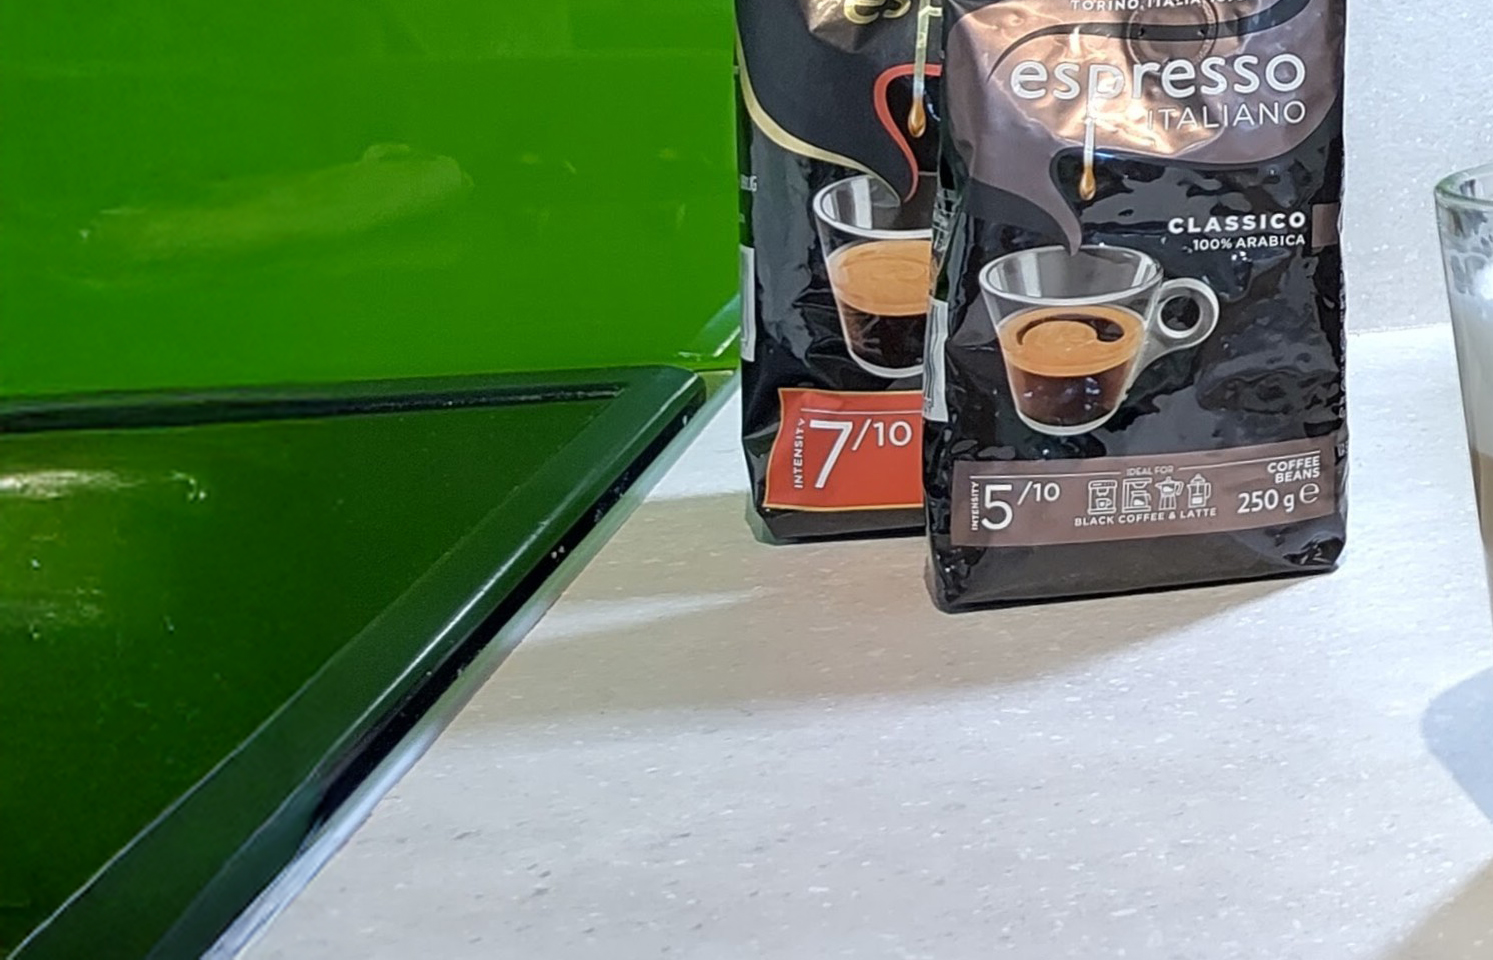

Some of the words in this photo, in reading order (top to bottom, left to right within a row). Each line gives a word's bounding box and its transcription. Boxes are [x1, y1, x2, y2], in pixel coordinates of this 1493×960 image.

[1010, 53, 1306, 112] espresso
[1147, 100, 1306, 131] ITALIANO
[1167, 211, 1307, 235] CLASSICO
[1193, 237, 1233, 251] 100%
[1235, 233, 1306, 249] ARABICA
[793, 417, 806, 489] INTENSITY
[1267, 455, 1320, 473] COFFEE
[1126, 467, 1153, 477] IDEAL
[1154, 465, 1174, 475] FOR
[1275, 467, 1320, 484] BEANS
[969, 480, 980, 531] INTENSITY
[1237, 488, 1279, 514] 250
[1074, 515, 1115, 528] BLACK
[1118, 511, 1165, 524] COFFEE
[1180, 507, 1217, 520] LATTE
